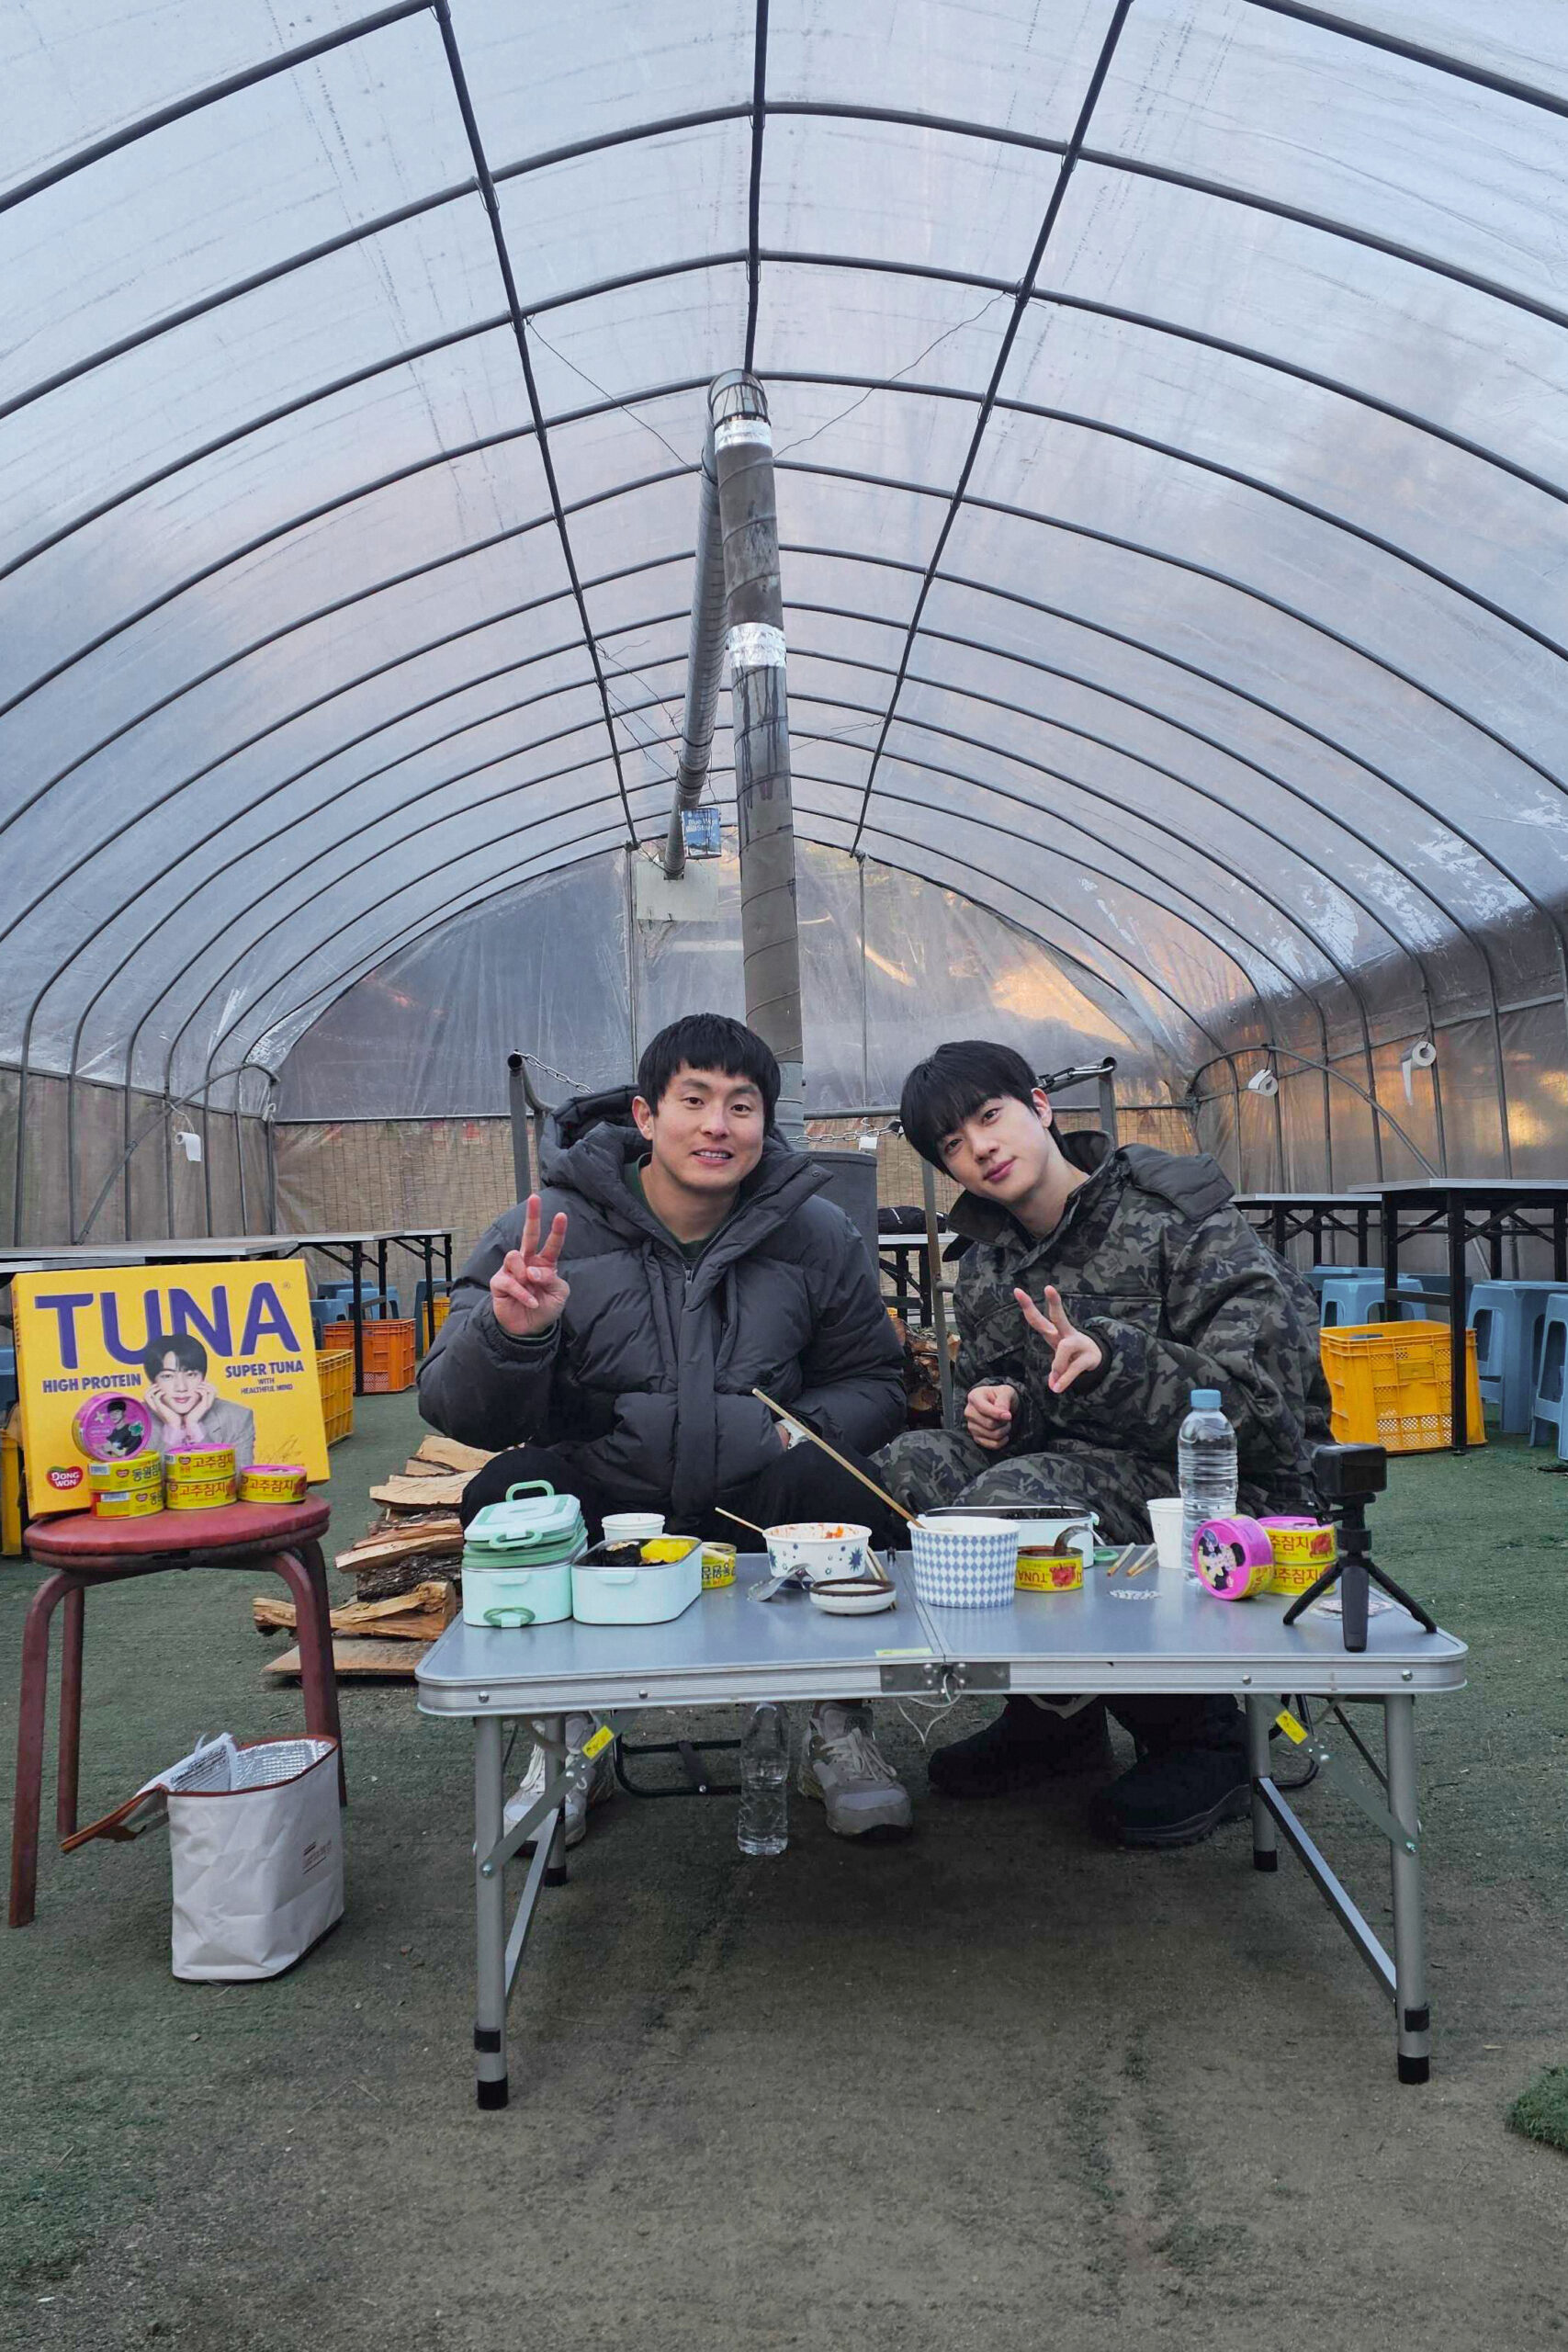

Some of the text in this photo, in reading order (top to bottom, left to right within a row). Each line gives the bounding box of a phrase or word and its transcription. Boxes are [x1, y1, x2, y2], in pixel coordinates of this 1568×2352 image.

[35, 1283, 301, 1370] TUNA
[225, 1360, 304, 1378] SUPER TUNA
[42, 1373, 141, 1394] HIGH PROTEIN
[51, 1471, 81, 1481] DONG
[55, 1479, 77, 1487] WON
[1018, 1571, 1048, 1584] TUNA
